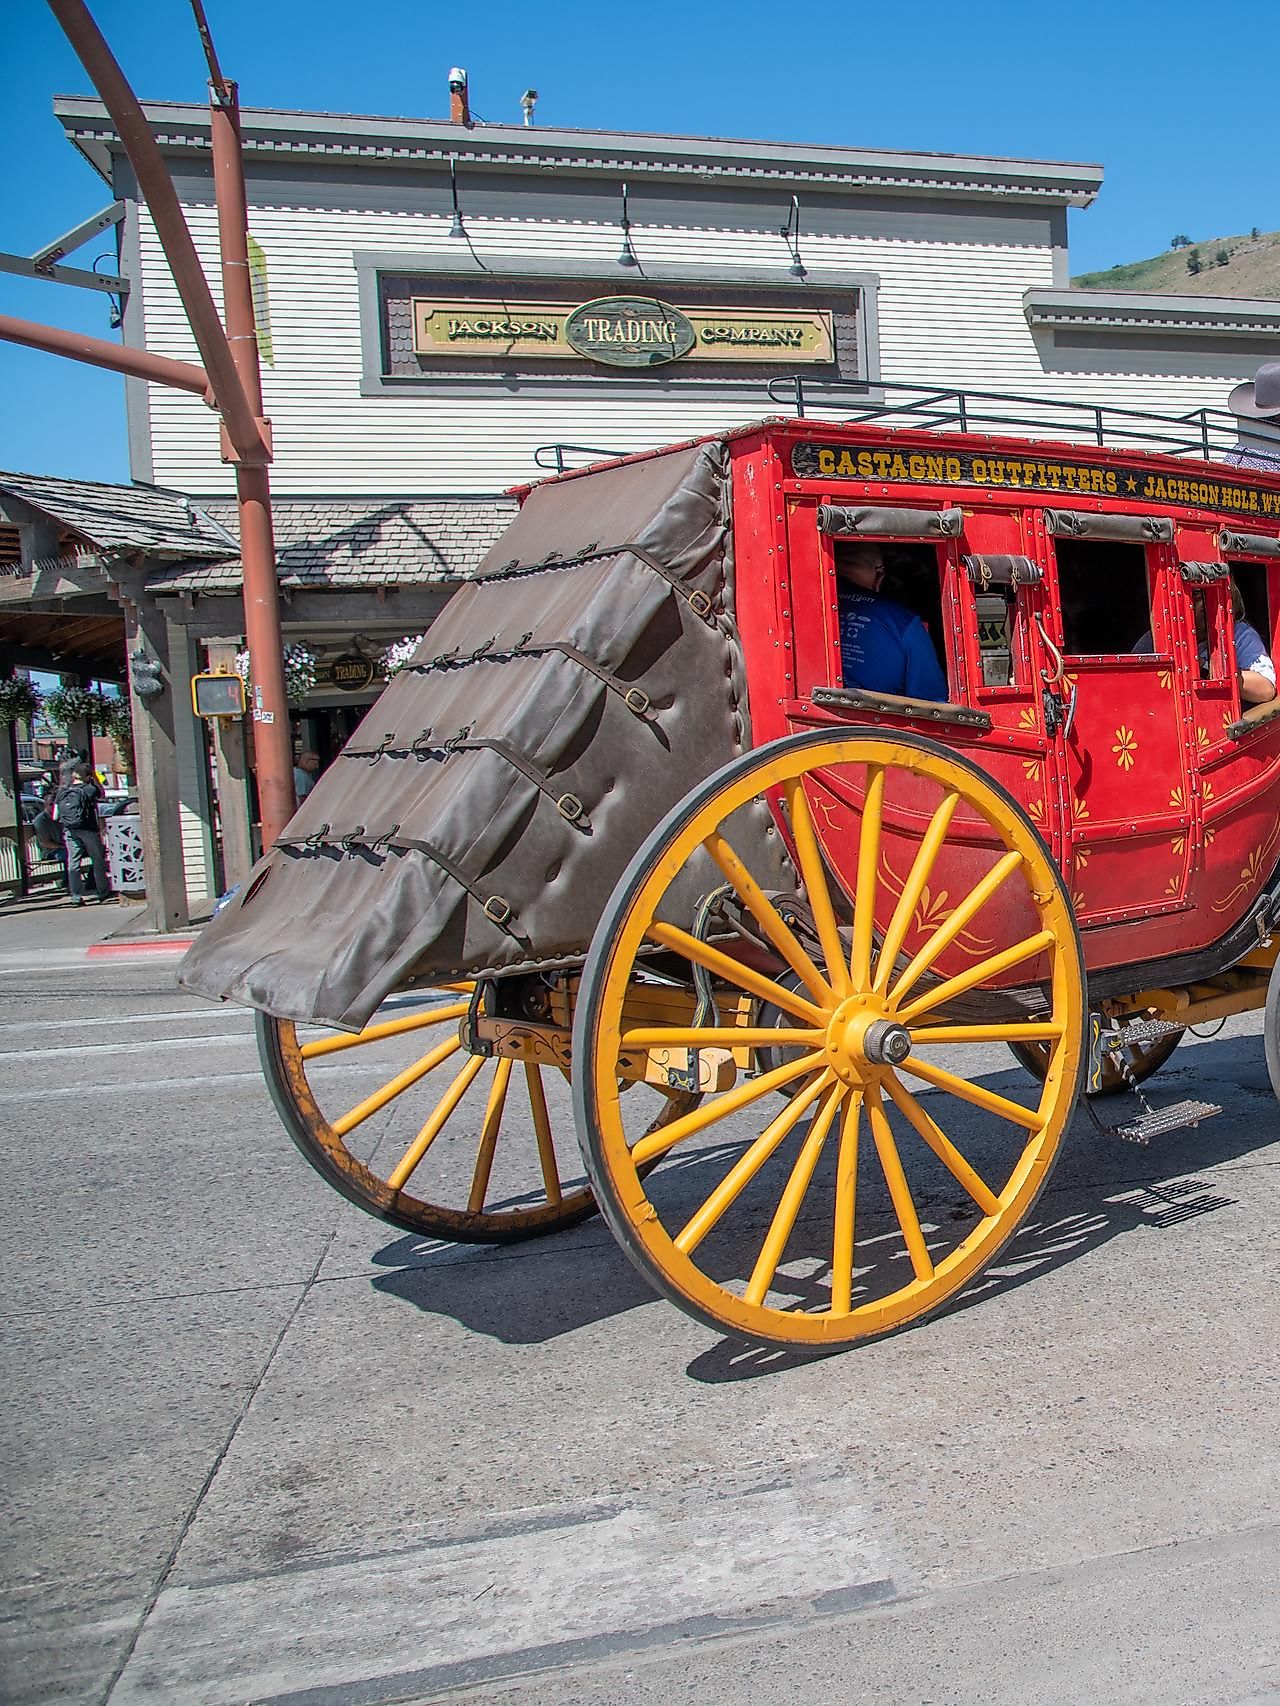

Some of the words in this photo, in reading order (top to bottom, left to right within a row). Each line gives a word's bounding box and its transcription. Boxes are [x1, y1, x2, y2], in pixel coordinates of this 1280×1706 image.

[449, 320, 557, 337] JACKSON
[584, 319, 678, 343] TRADING
[700, 327, 801, 343] COMPANY
[818, 449, 961, 480] CASTAGNO
[972, 459, 1117, 493] OUTFITTERS
[1144, 476, 1219, 504] JACKSON
[335, 663, 367, 680] TRADING
[228, 686, 239, 705] 4
